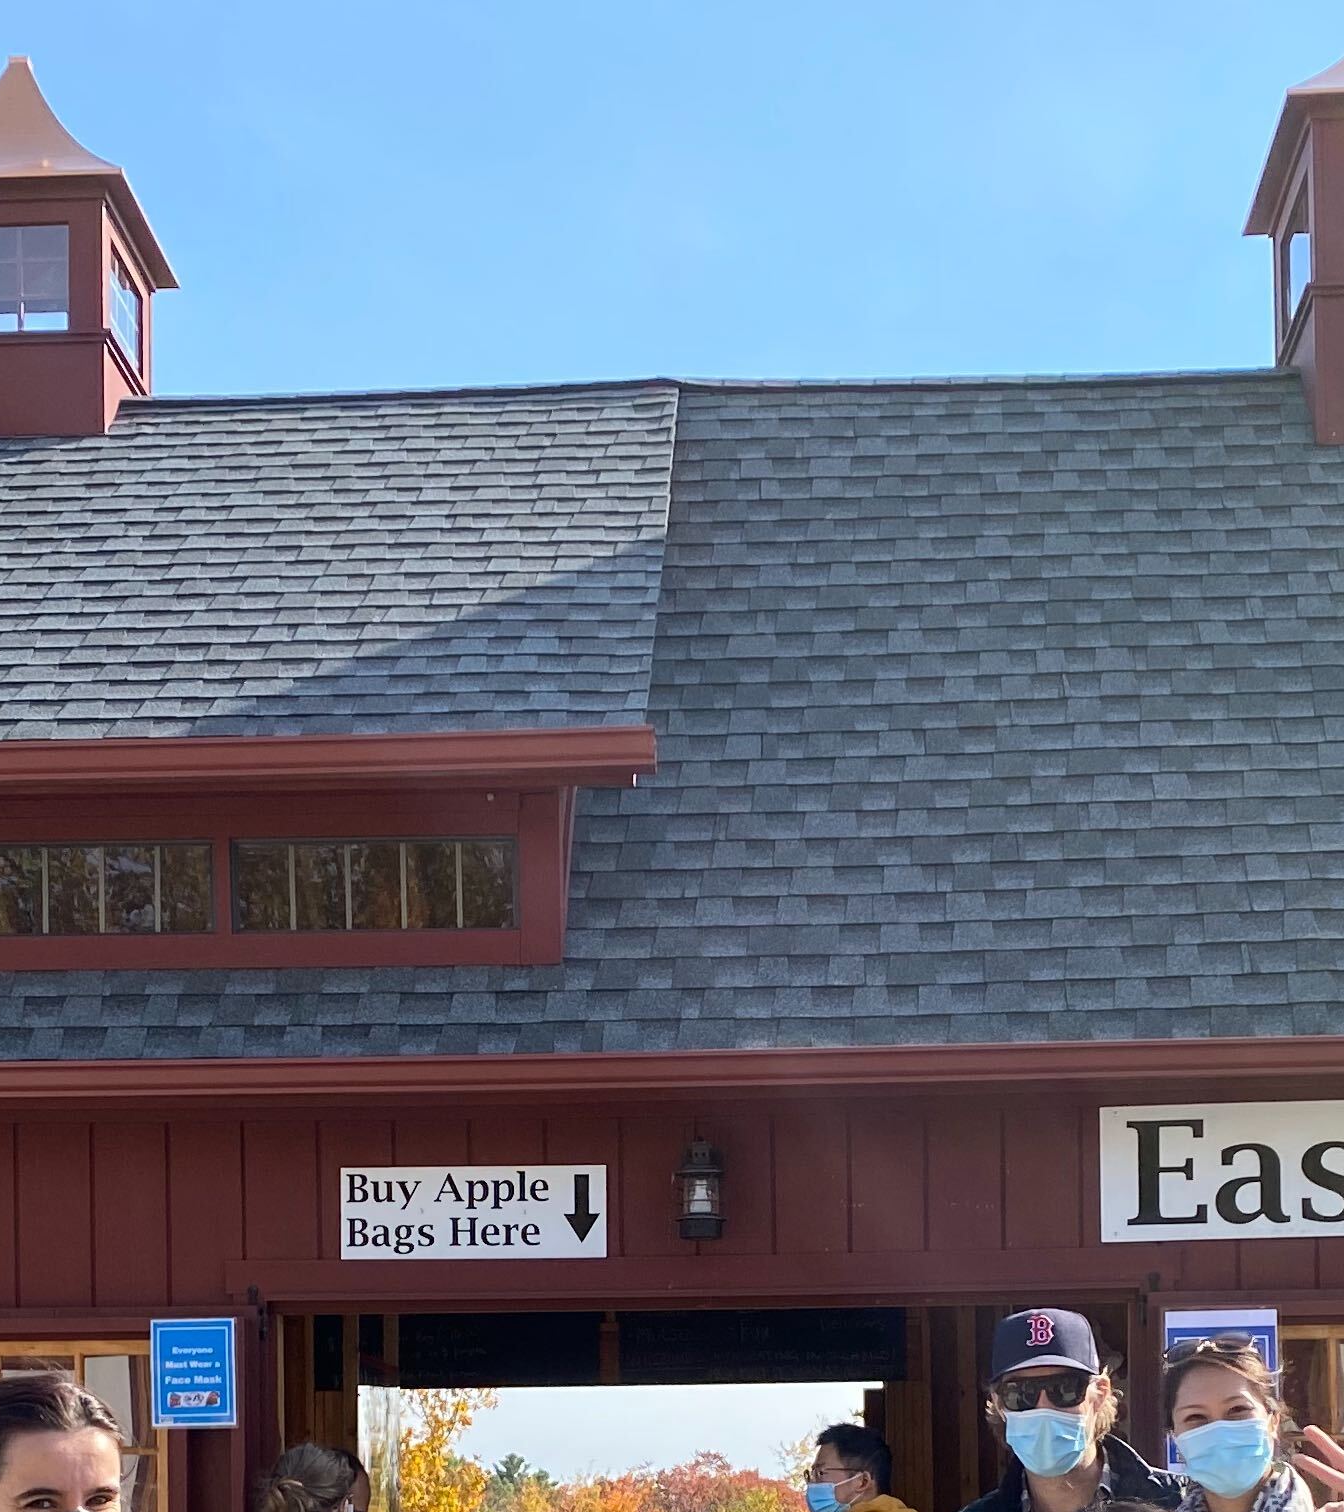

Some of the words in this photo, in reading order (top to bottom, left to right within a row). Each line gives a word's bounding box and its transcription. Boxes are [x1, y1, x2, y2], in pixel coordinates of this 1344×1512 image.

[345, 1173, 422, 1210] Buy
[434, 1171, 550, 1210] Apple
[346, 1218, 435, 1254] Bags
[449, 1217, 541, 1249] Here
[1026, 1314, 1055, 1347] B
[172, 1346, 213, 1355] Everyone
[165, 1376, 191, 1384] Face
